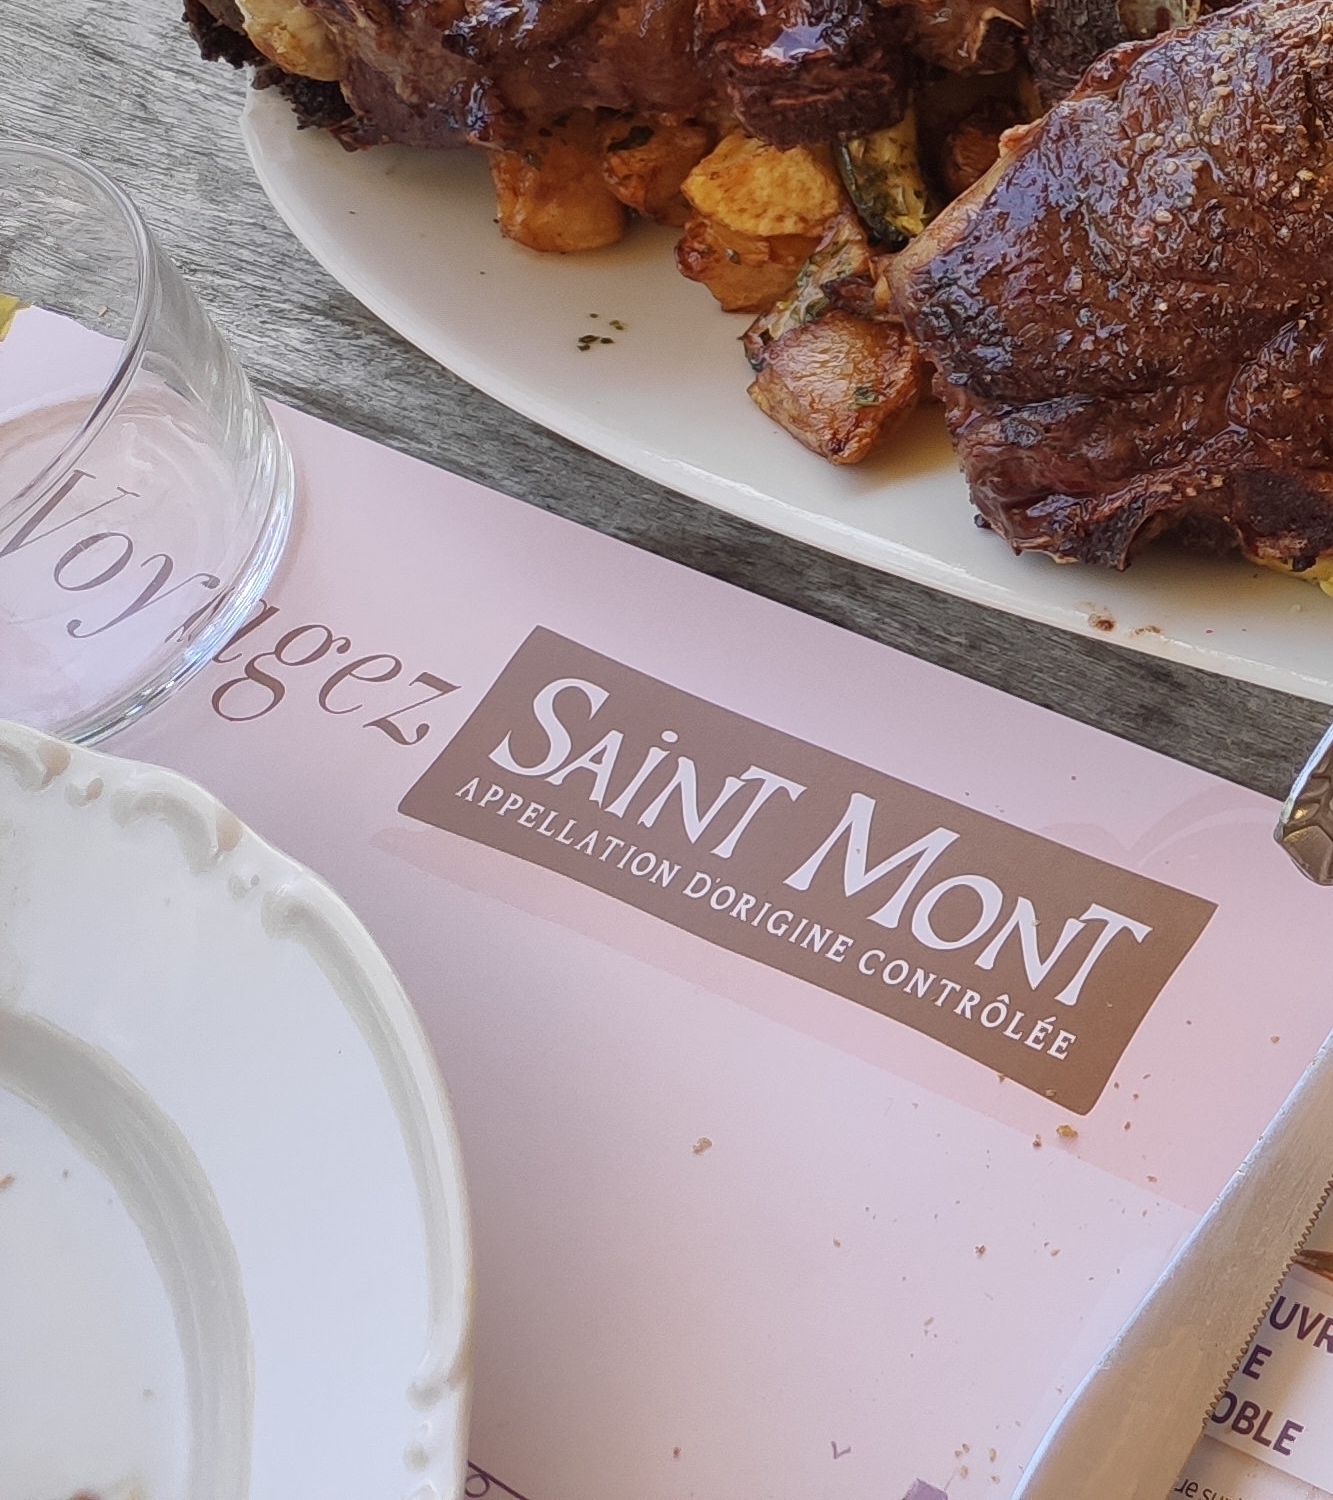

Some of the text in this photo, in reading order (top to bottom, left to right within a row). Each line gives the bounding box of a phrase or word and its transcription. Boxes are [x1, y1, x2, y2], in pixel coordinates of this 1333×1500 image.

[455, 776, 1077, 1061] APPELLATION D'ORIGINE CONTRÔLÉE
[783, 792, 1154, 1007] MONT
[1210, 1391, 1305, 1456] OBLE
